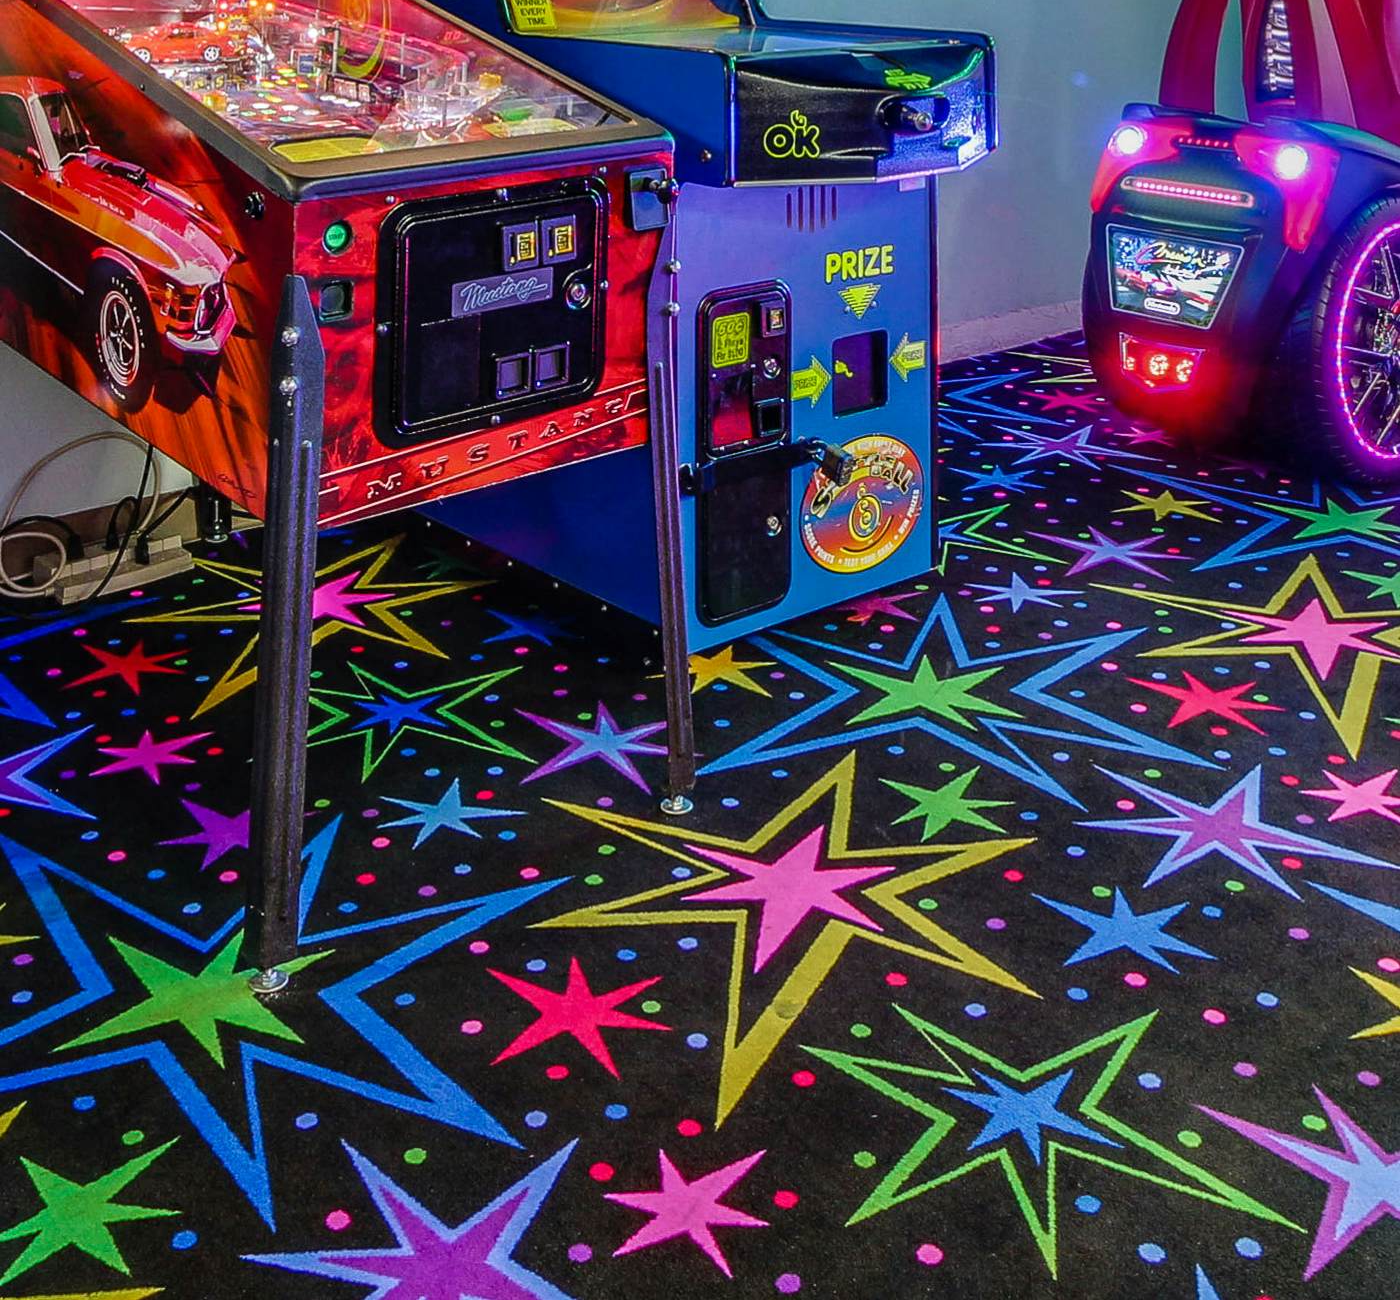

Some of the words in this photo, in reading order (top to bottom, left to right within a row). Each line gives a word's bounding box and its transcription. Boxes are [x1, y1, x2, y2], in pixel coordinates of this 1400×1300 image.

[520, 7, 547, 16] EVERY
[527, 17, 547, 26] TIME
[824, 244, 894, 284] PRIZE
[460, 276, 548, 312] Mustang
[366, 397, 630, 500] MUSTANG
